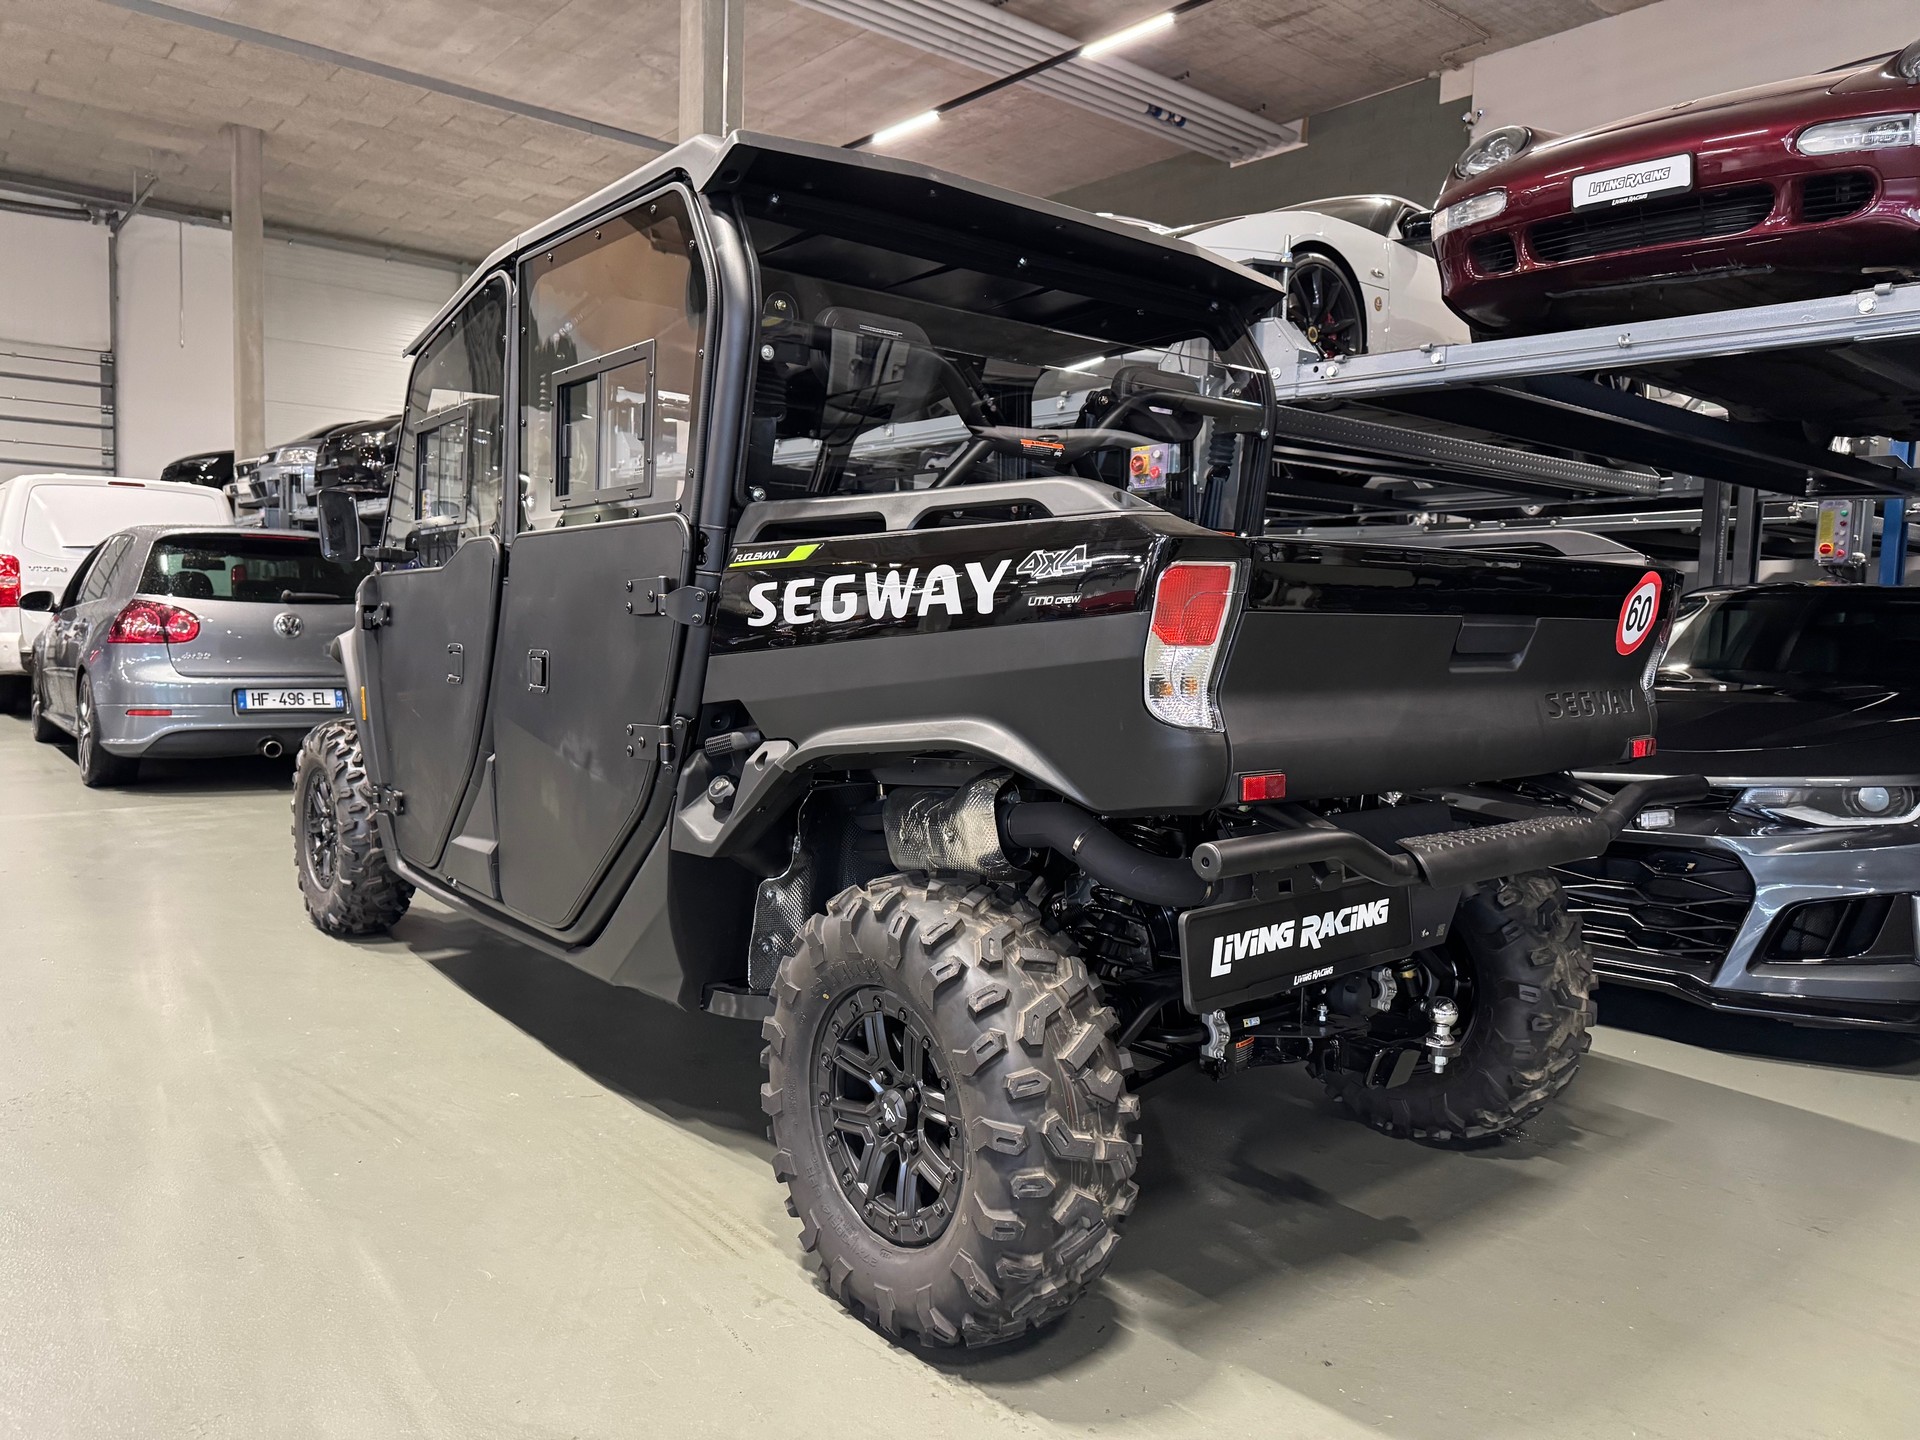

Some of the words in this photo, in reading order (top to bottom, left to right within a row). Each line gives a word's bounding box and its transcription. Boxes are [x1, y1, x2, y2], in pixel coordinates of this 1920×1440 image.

[747, 559, 1013, 627] SEGWAY
[1028, 596, 1054, 606] UT10
[1054, 595, 1082, 605] CREW
[1625, 594, 1652, 632] 60
[1544, 688, 1636, 719] SEGWAY
